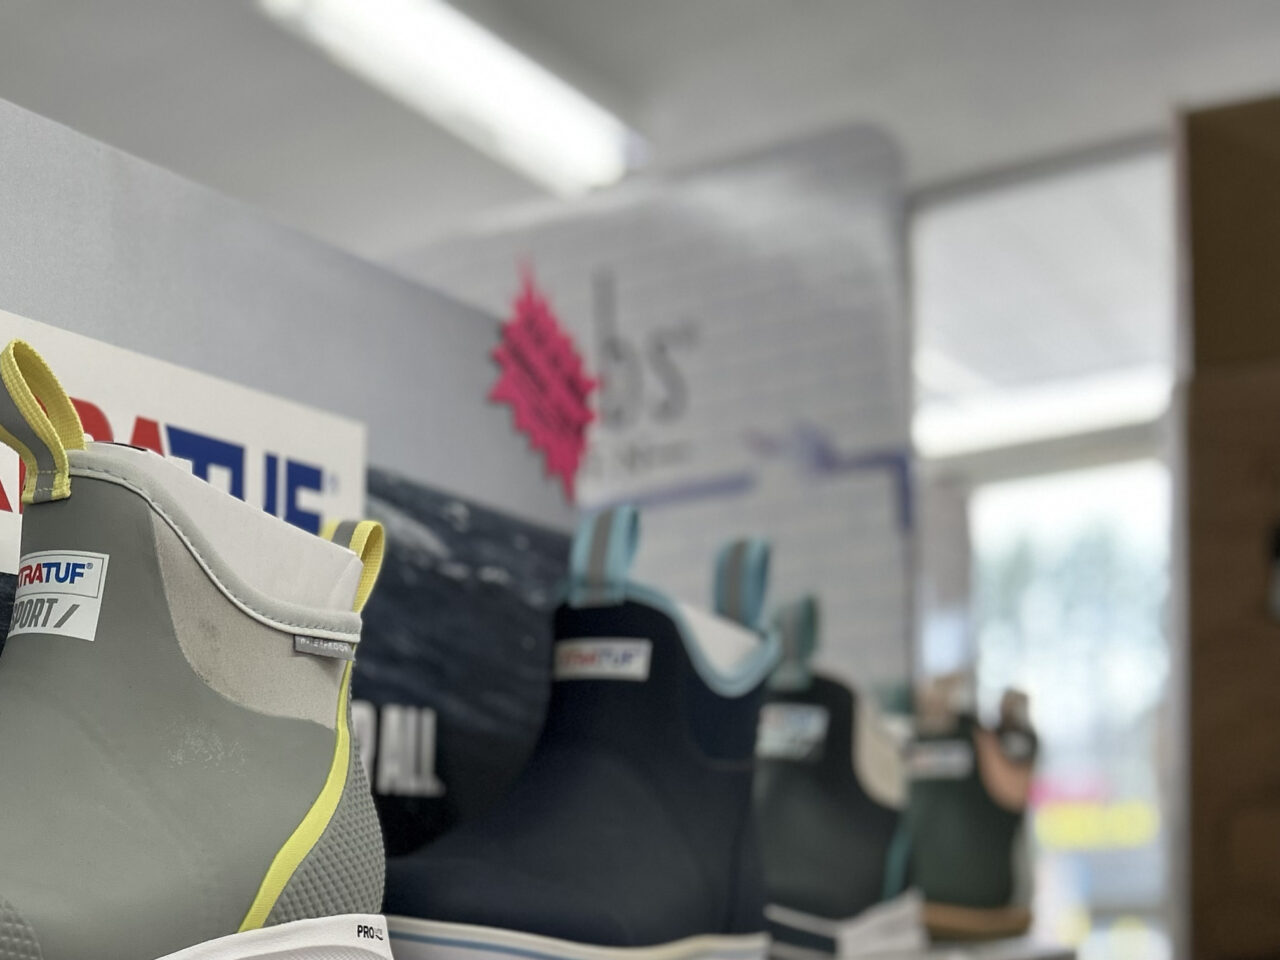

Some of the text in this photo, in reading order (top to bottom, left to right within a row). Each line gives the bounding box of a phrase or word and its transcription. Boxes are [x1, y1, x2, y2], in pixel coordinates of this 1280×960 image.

[17, 562, 86, 588] TRATUF
[8, 598, 59, 633] PORT
[377, 703, 446, 797] ALL
